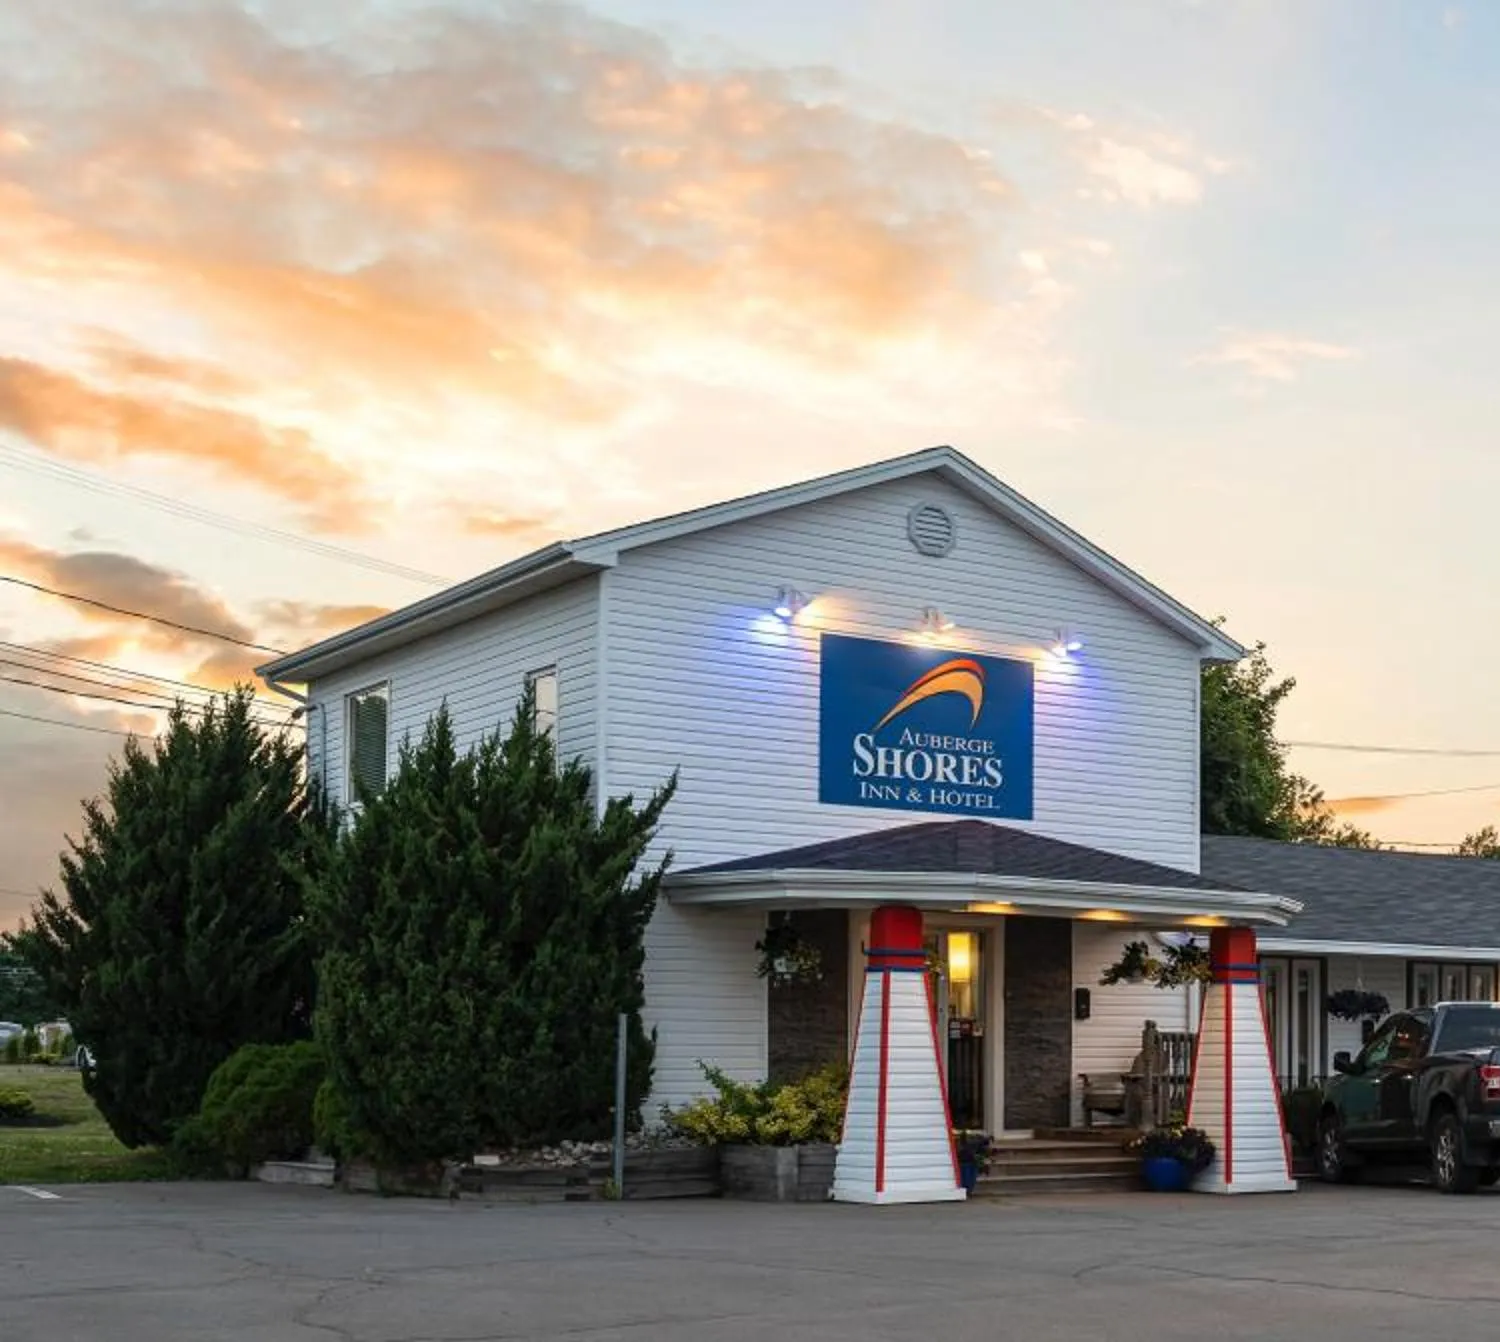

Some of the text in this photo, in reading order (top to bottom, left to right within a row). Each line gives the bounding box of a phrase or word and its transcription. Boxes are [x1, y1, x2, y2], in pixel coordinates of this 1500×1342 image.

[900, 727, 995, 754] AUBERGE
[853, 733, 1003, 788] SHORES
[860, 781, 900, 801] INN
[906, 787, 923, 803] &
